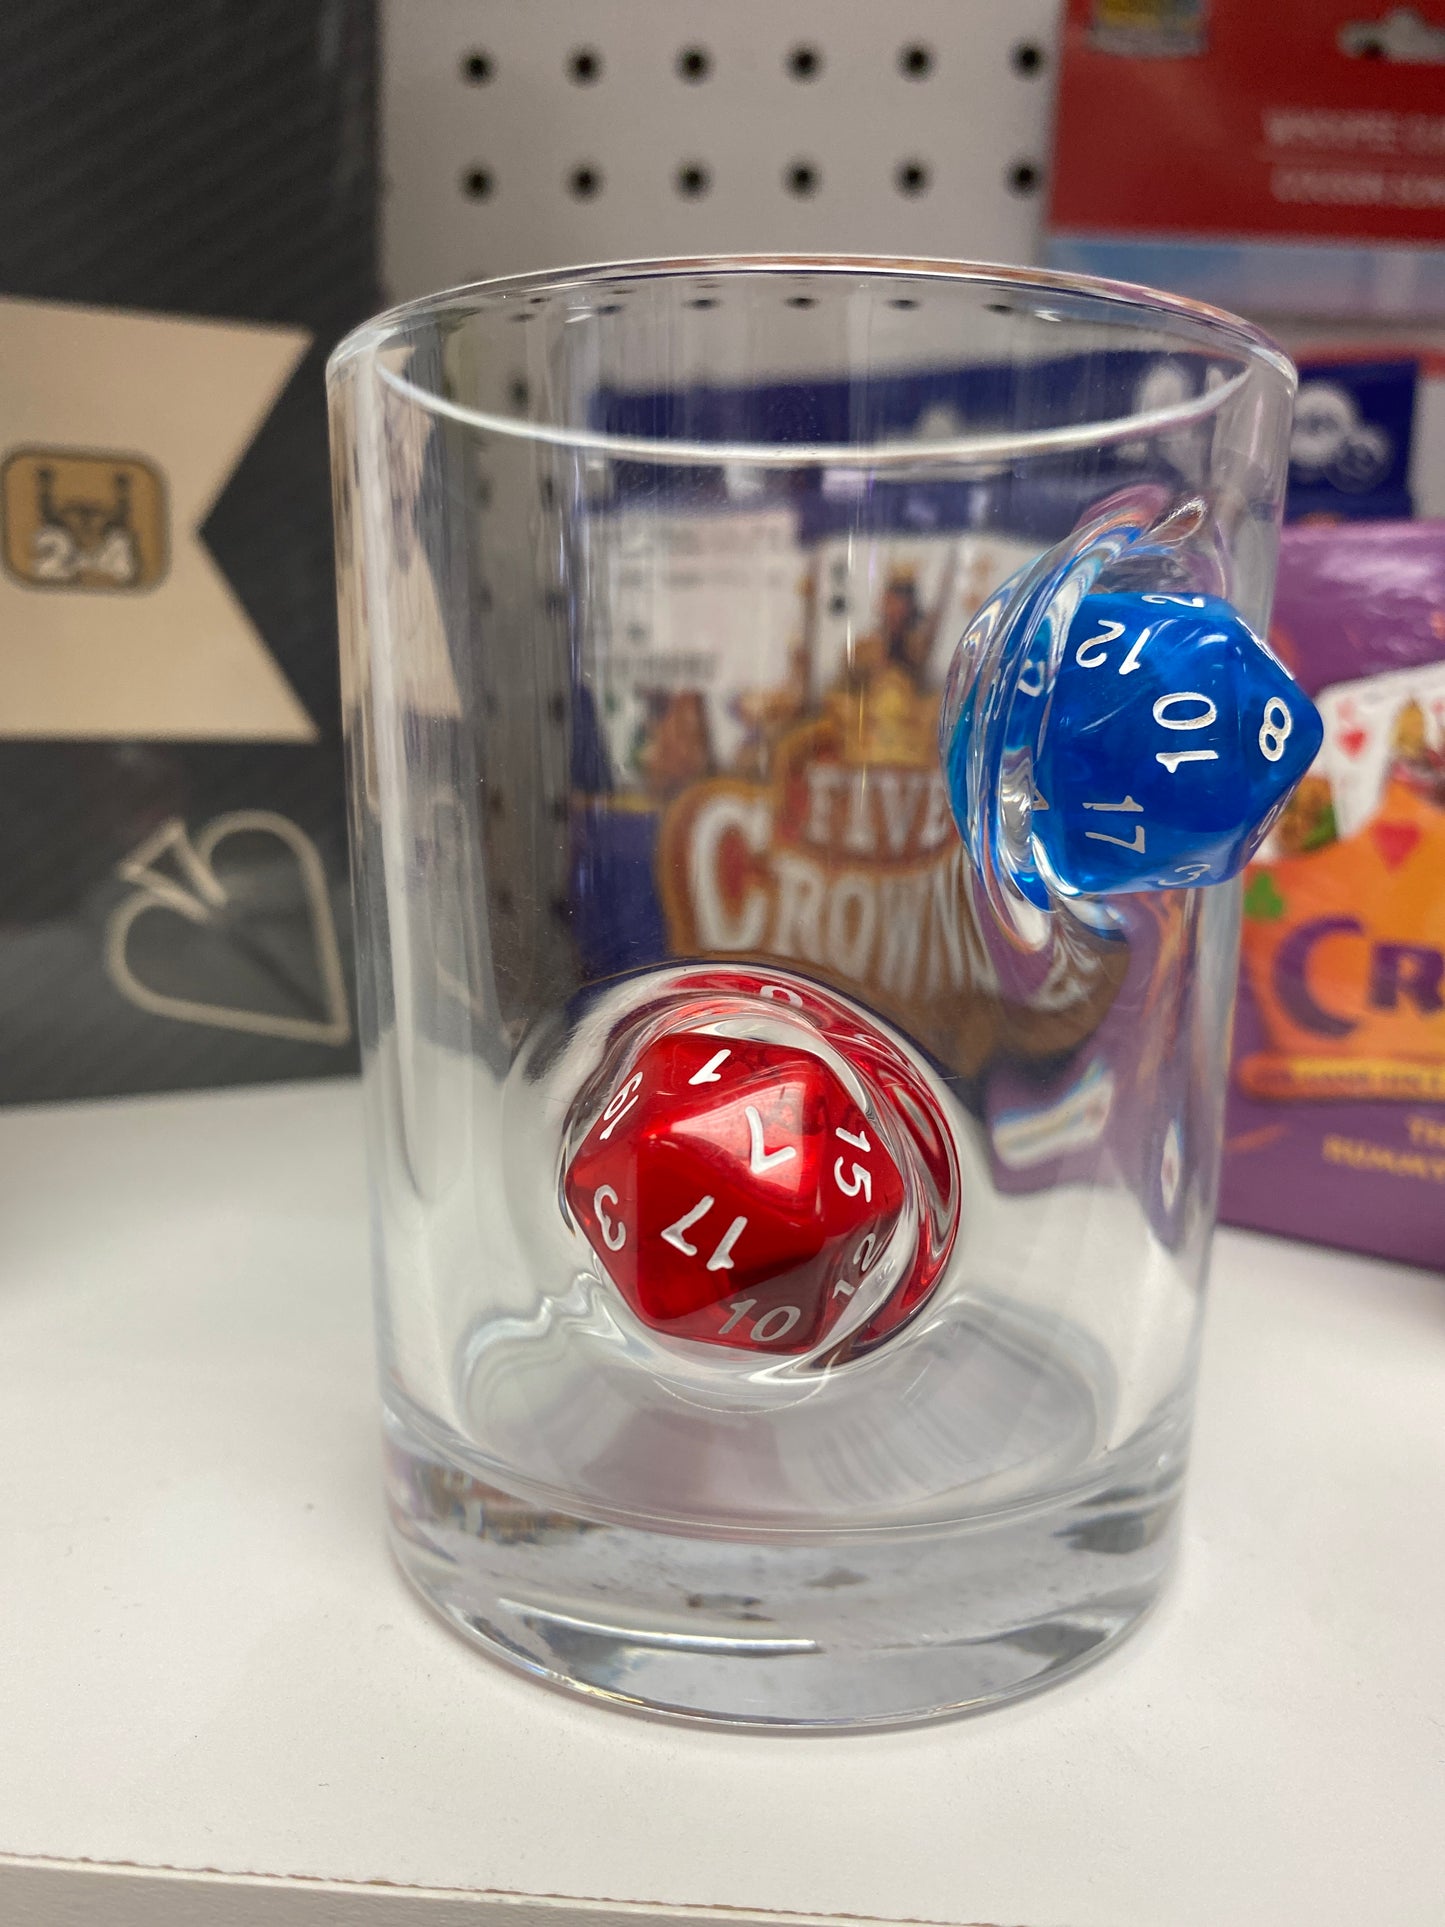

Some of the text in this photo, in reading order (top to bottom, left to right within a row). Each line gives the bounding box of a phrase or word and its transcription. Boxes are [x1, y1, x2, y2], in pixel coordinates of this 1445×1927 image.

[1075, 620, 1151, 675] 12
[1152, 691, 1219, 773] 10
[1259, 696, 1293, 762] 8
[1082, 795, 1146, 854] 17
[1272, 914, 1445, 1040] CR
[688, 1050, 731, 1085] 1
[745, 1106, 796, 1174] 7
[834, 1126, 872, 1202] 15
[594, 1184, 627, 1252] 3
[661, 1195, 748, 1271] 17
[718, 1299, 801, 1342] 10
